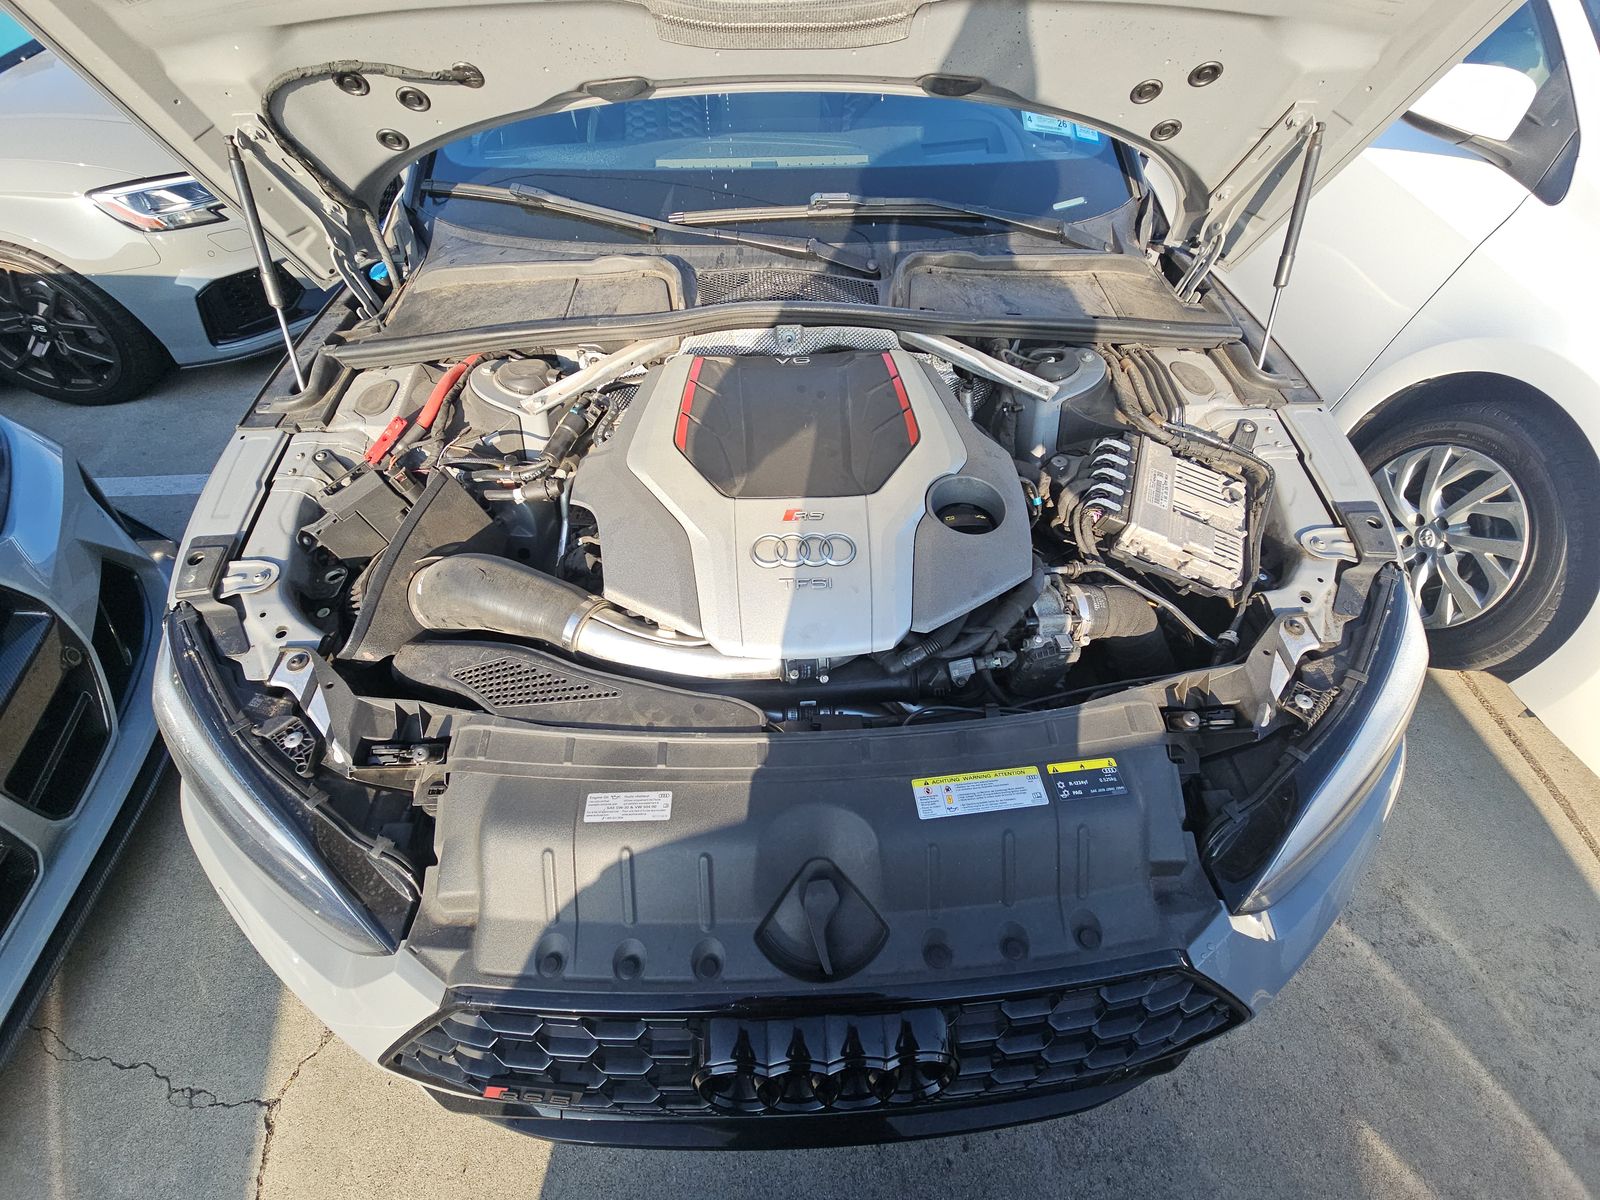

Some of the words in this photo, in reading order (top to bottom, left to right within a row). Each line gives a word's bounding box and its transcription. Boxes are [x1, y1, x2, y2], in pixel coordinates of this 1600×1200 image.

[1027, 115, 1033, 123] 4
[1057, 119, 1068, 129] 26
[31, 324, 48, 333] RS
[775, 356, 811, 365] V6
[789, 510, 825, 521] RS
[778, 577, 833, 590] TFSI
[931, 776, 961, 785] ACHTUNG
[963, 773, 991, 781] WARNING
[994, 770, 1026, 778] ATTENTION
[493, 1088, 572, 1108] RS5
